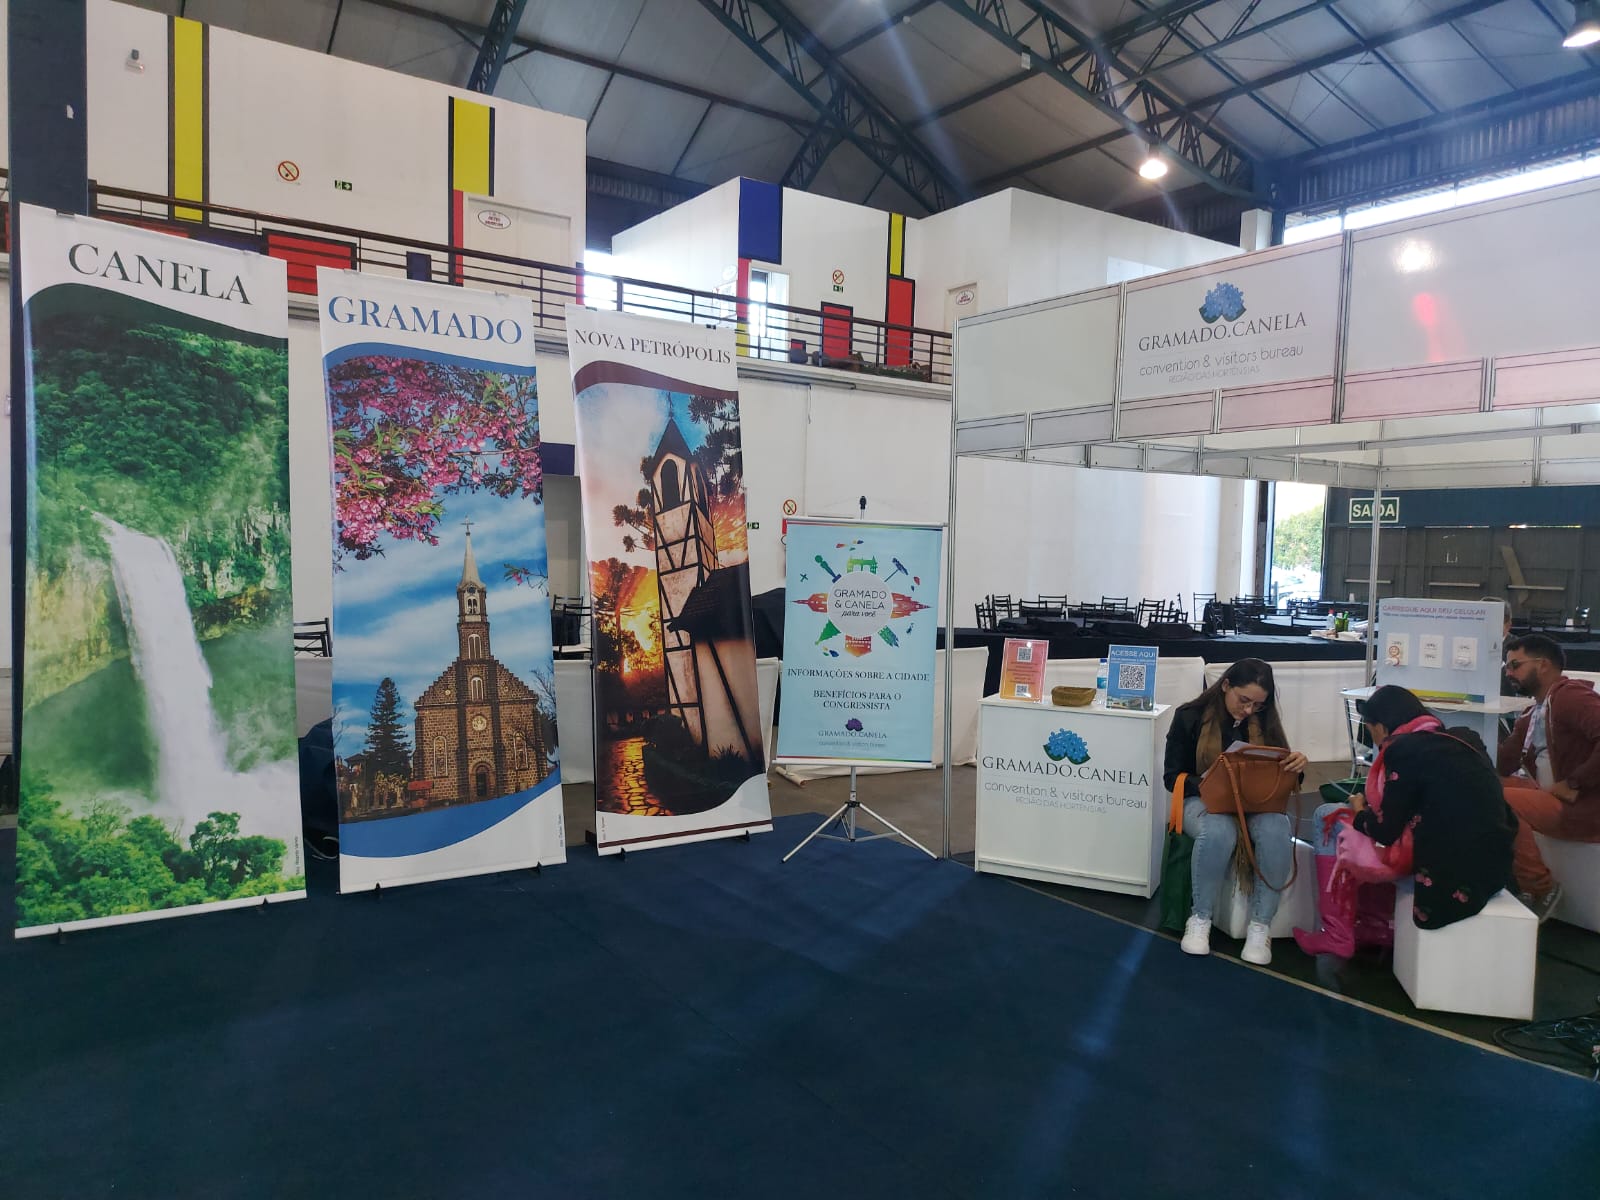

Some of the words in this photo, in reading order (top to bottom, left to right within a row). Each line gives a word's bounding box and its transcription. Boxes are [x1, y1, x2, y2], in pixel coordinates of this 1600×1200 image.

[69, 243, 252, 305] CANELA
[329, 296, 521, 345] GRAMADO
[1139, 312, 1306, 351] GRAMADO.CANELA
[575, 330, 625, 350] NOVA
[631, 338, 730, 364] PETRÓPOLIS
[1140, 357, 1200, 376] convention
[1203, 354, 1210, 368] &
[1215, 351, 1257, 366] visitors
[1260, 345, 1303, 361] bureau
[834, 589, 887, 599] GRAMADO
[834, 600, 841, 608] &
[844, 600, 885, 609] CANELA
[788, 668, 852, 678] INFORMAÇÕES
[855, 671, 884, 680] SOBRE
[887, 672, 892, 680] A
[895, 672, 930, 681] CIDADE
[813, 688, 866, 699] BENEFÍCIOS
[869, 691, 892, 700] PARA
[894, 692, 902, 700] O
[823, 700, 890, 710] CONGRESSISTA
[982, 756, 1149, 786] GRAMADO.CANELA
[984, 782, 1048, 796] convention
[1050, 787, 1057, 798] &
[1061, 790, 1104, 804] visitors
[1106, 794, 1147, 809] bureau
